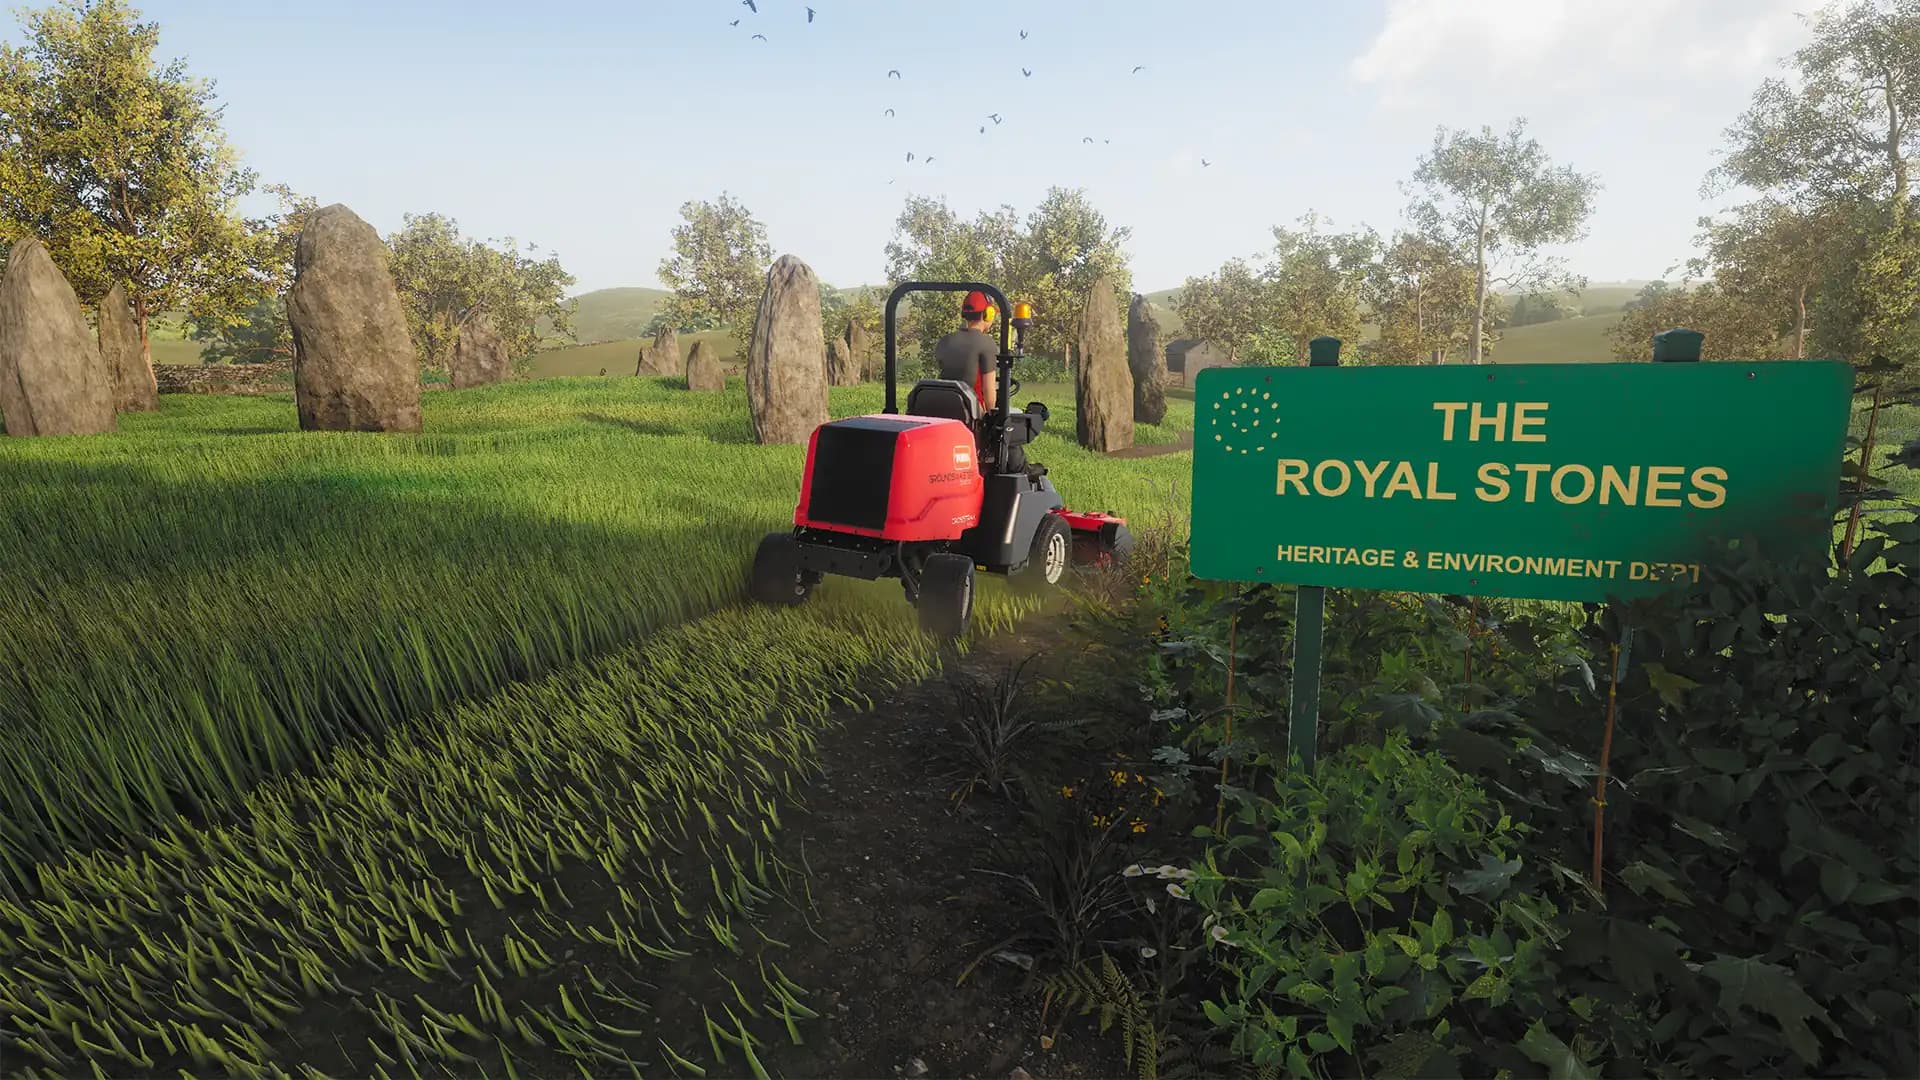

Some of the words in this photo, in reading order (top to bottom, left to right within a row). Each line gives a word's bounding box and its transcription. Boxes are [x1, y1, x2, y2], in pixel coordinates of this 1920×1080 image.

[1433, 402, 1549, 442] THE
[1276, 458, 1457, 500] ROYAL
[1475, 462, 1728, 509] STONES
[1277, 544, 1394, 567] HERITAGE
[1402, 551, 1420, 569] &
[1427, 552, 1622, 579] ENVIRONMENT
